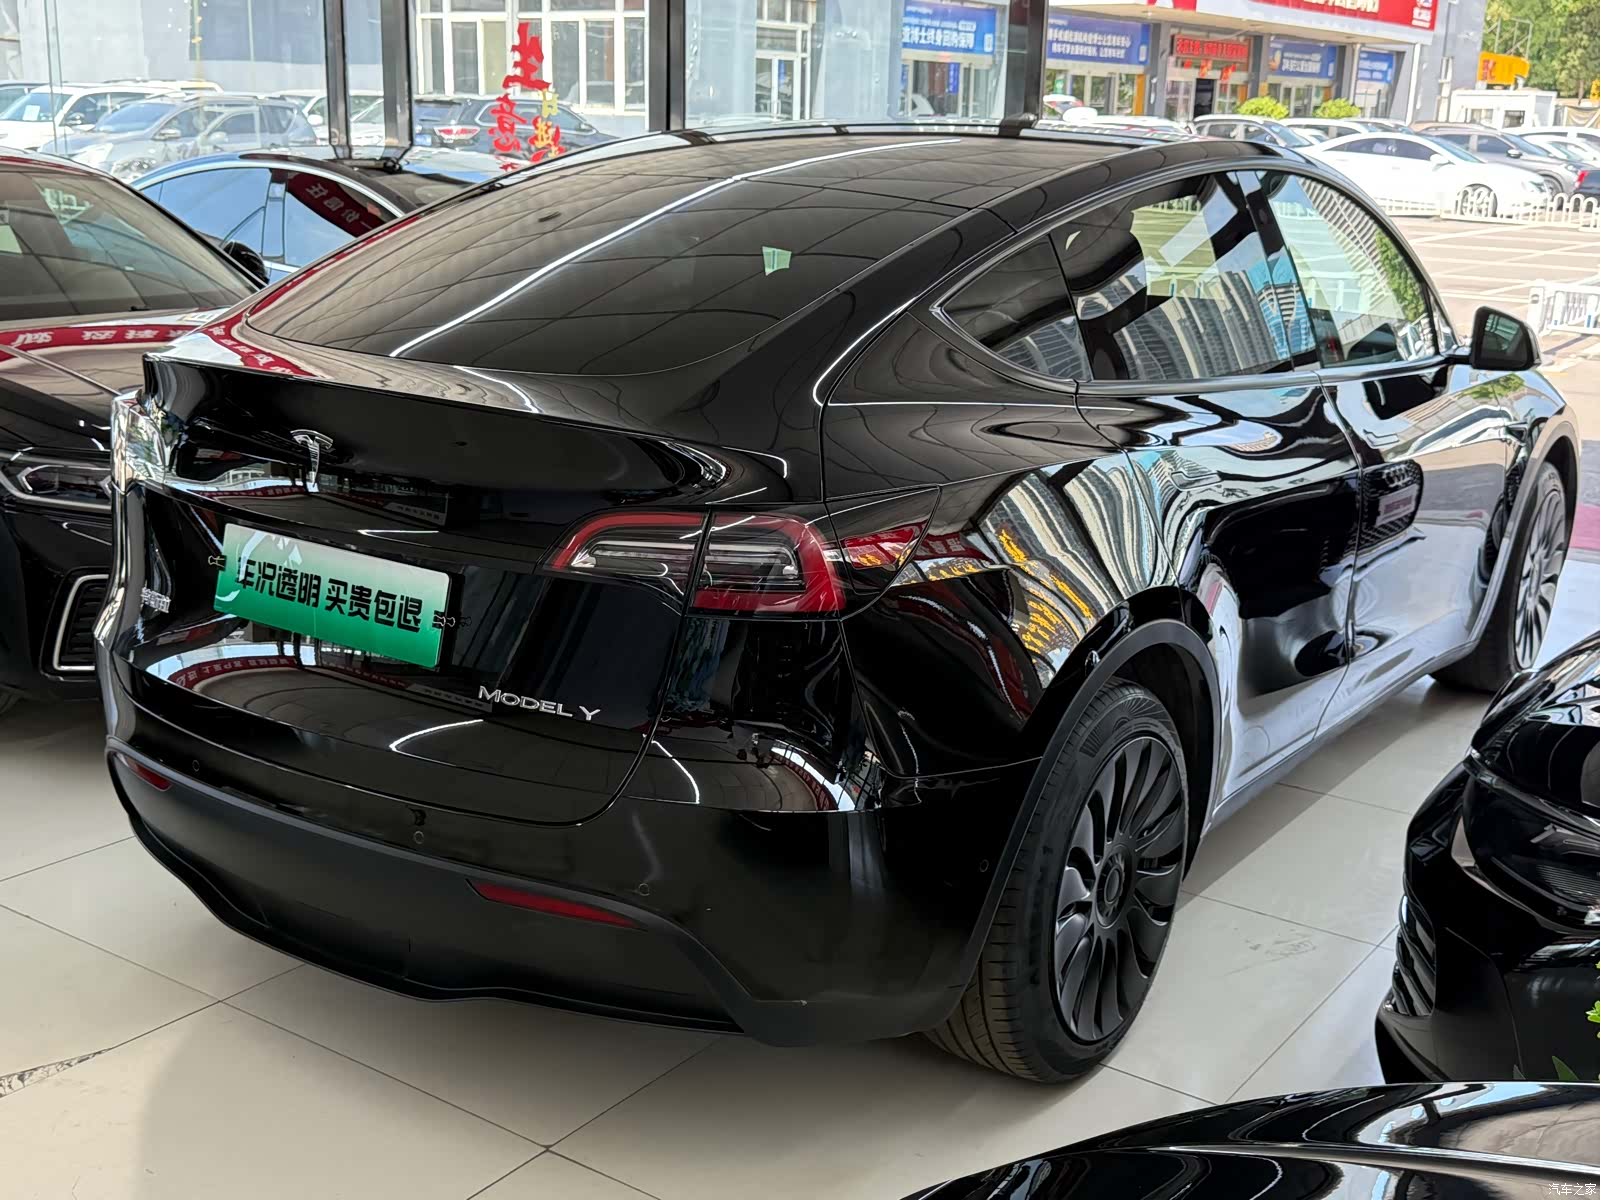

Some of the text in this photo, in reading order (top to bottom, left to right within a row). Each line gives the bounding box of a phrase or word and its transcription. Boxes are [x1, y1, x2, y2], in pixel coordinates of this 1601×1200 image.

[235, 557, 423, 632] 车况透明 买贵包退
[478, 685, 601, 721] MODEL Y
